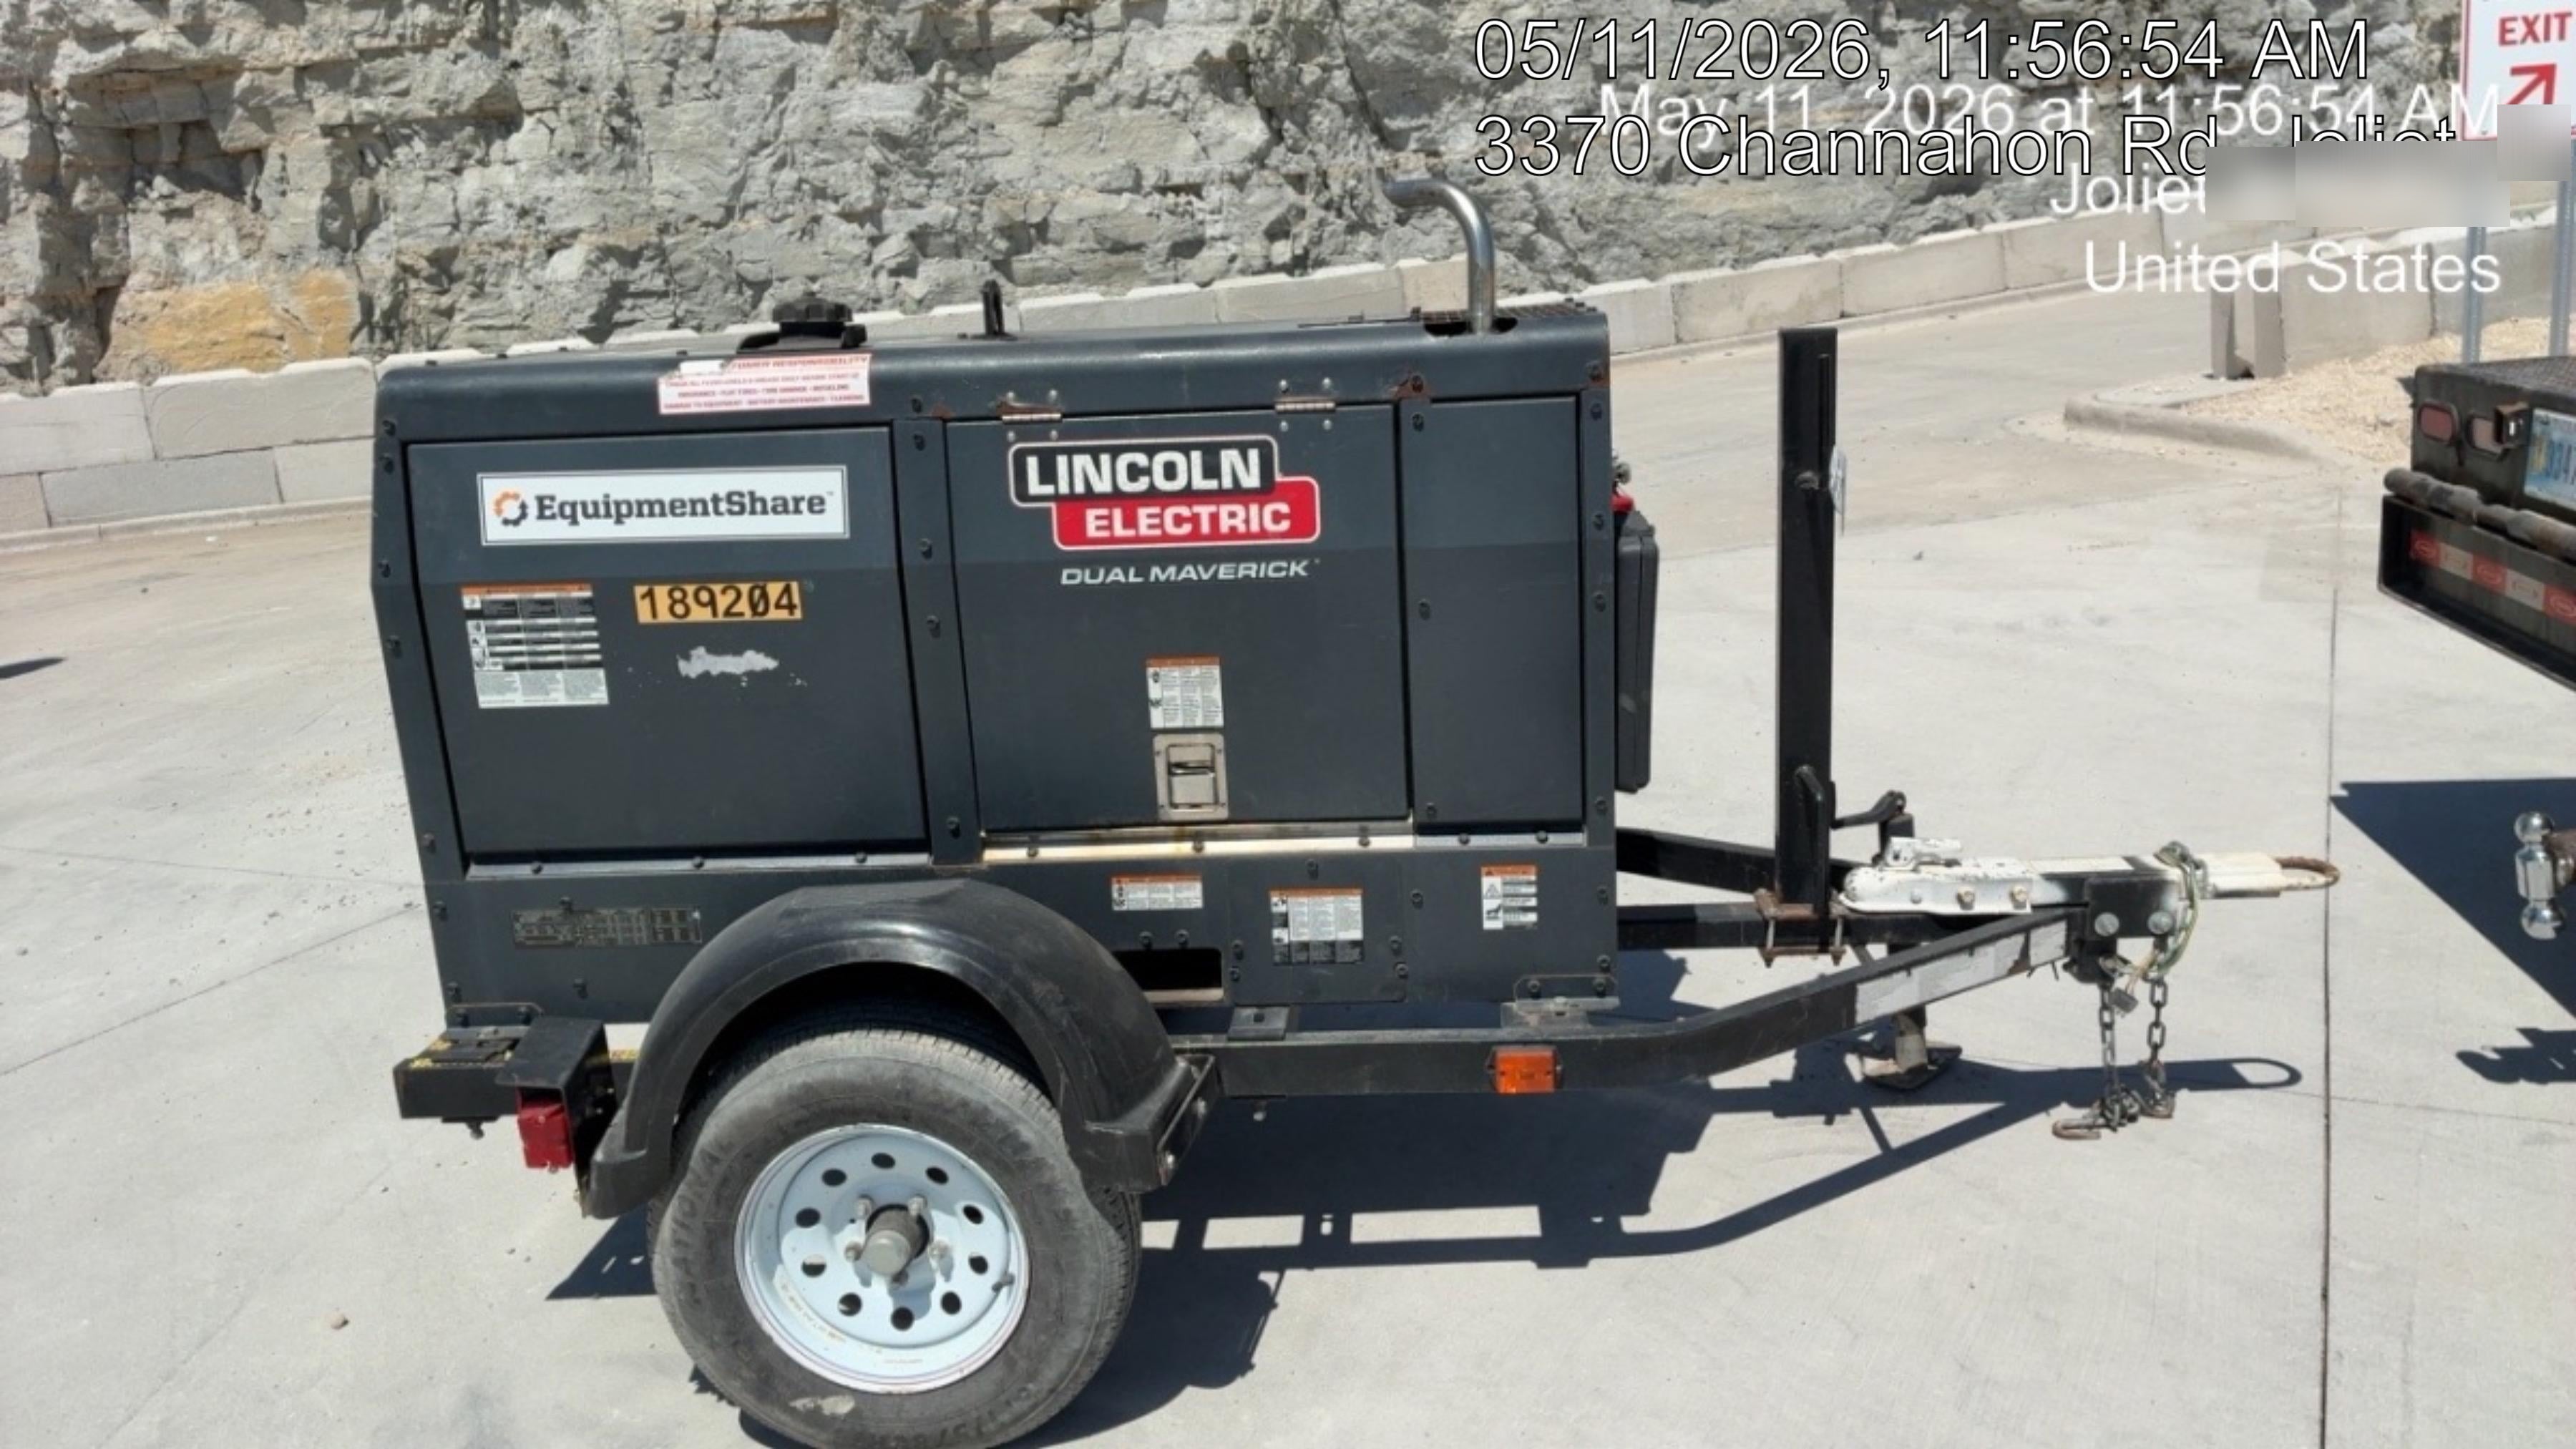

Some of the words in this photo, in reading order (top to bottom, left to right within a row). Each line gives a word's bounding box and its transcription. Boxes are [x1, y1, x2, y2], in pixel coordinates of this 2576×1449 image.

[2498, 12, 2572, 46] EXIT
[1025, 448, 1262, 496] LINCOLN
[534, 490, 828, 526] EquipmentShare
[1085, 502, 1292, 538] ELECTRIC
[1060, 567, 1144, 585] DUAL
[1148, 560, 1310, 583] MAVERICK
[640, 582, 799, 620] 189204
